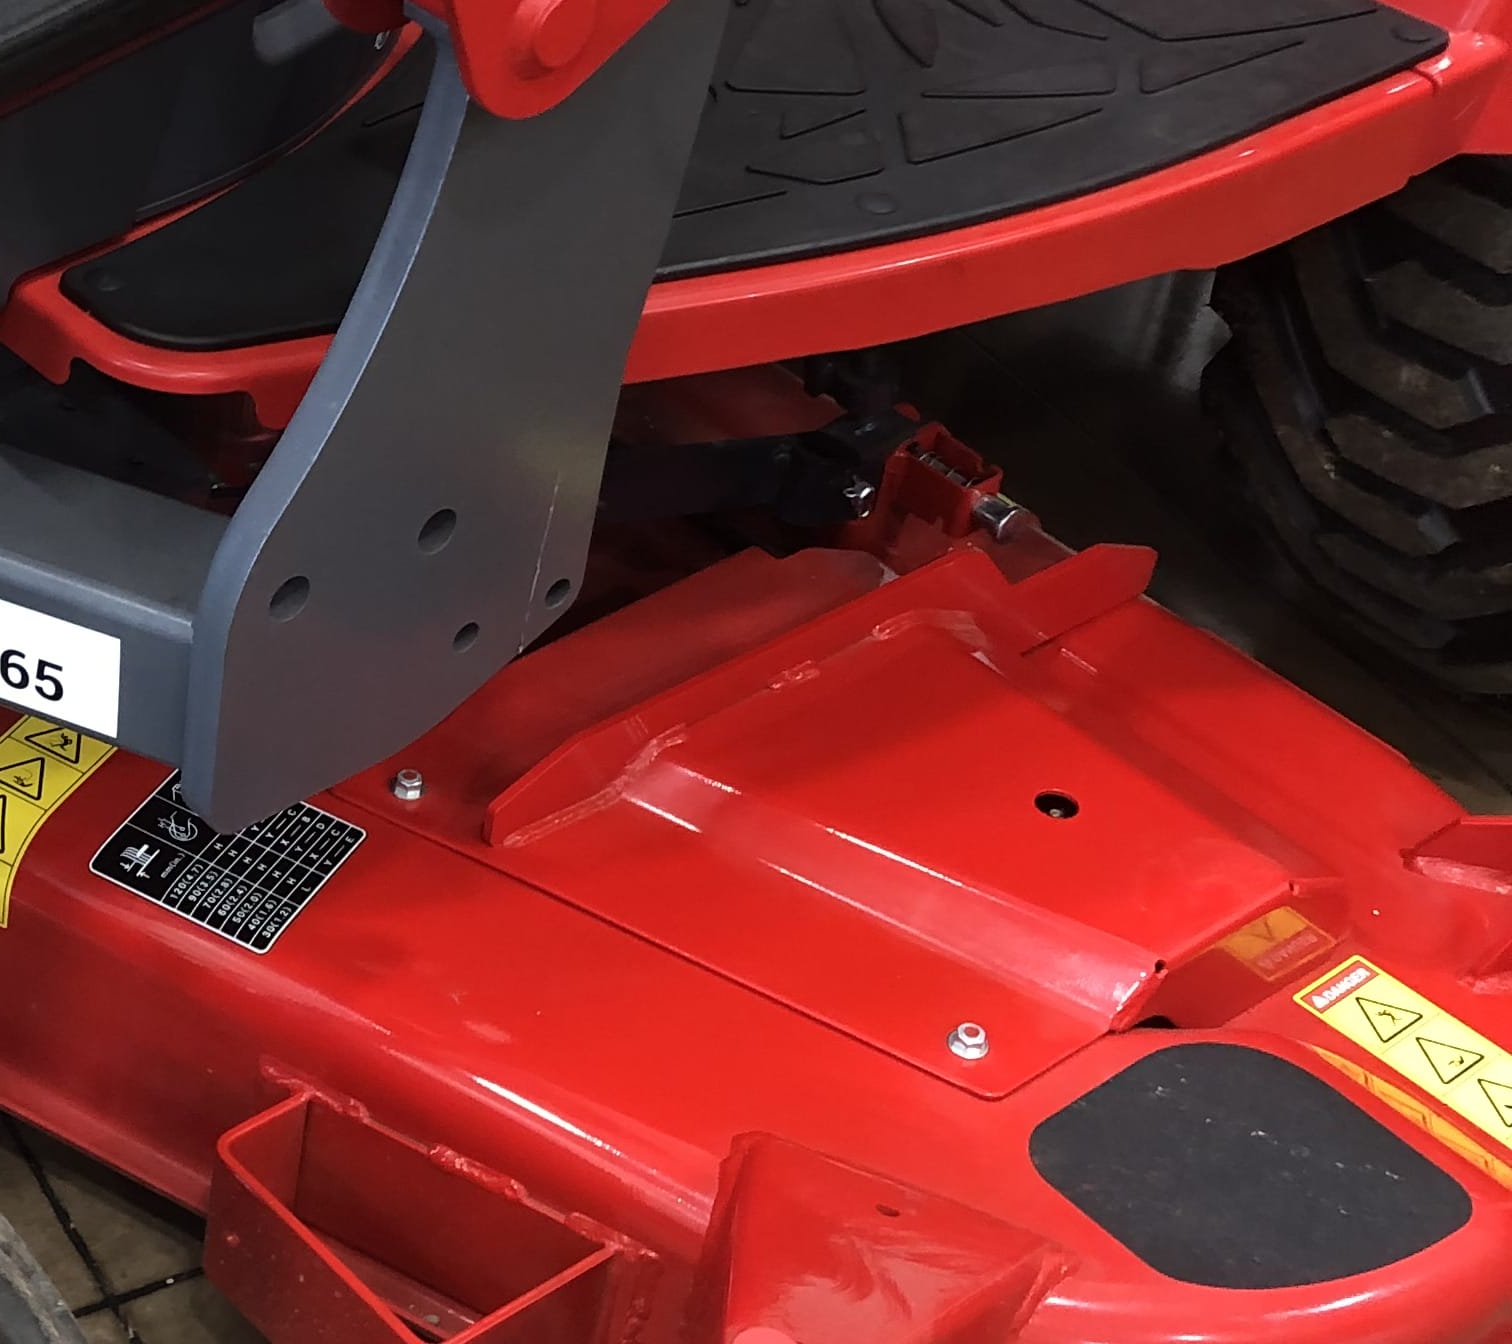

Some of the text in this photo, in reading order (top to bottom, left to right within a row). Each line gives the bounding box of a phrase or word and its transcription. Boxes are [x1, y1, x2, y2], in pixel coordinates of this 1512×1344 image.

[170, 842, 224, 899] 120(4.7) H
[188, 870, 219, 902] 90(3.5)
[228, 849, 238, 858] H
[202, 878, 233, 909] 70(2.8)
[242, 856, 252, 864] H
[287, 809, 297, 817] C
[248, 899, 277, 931] 40(1.6)
[286, 877, 296, 885] H
[331, 829, 340, 837] C
[257, 863, 267, 871] H
[232, 892, 262, 923] 50(2.0)
[272, 870, 282, 878] H
[262, 906, 292, 938] 30(1.2)
